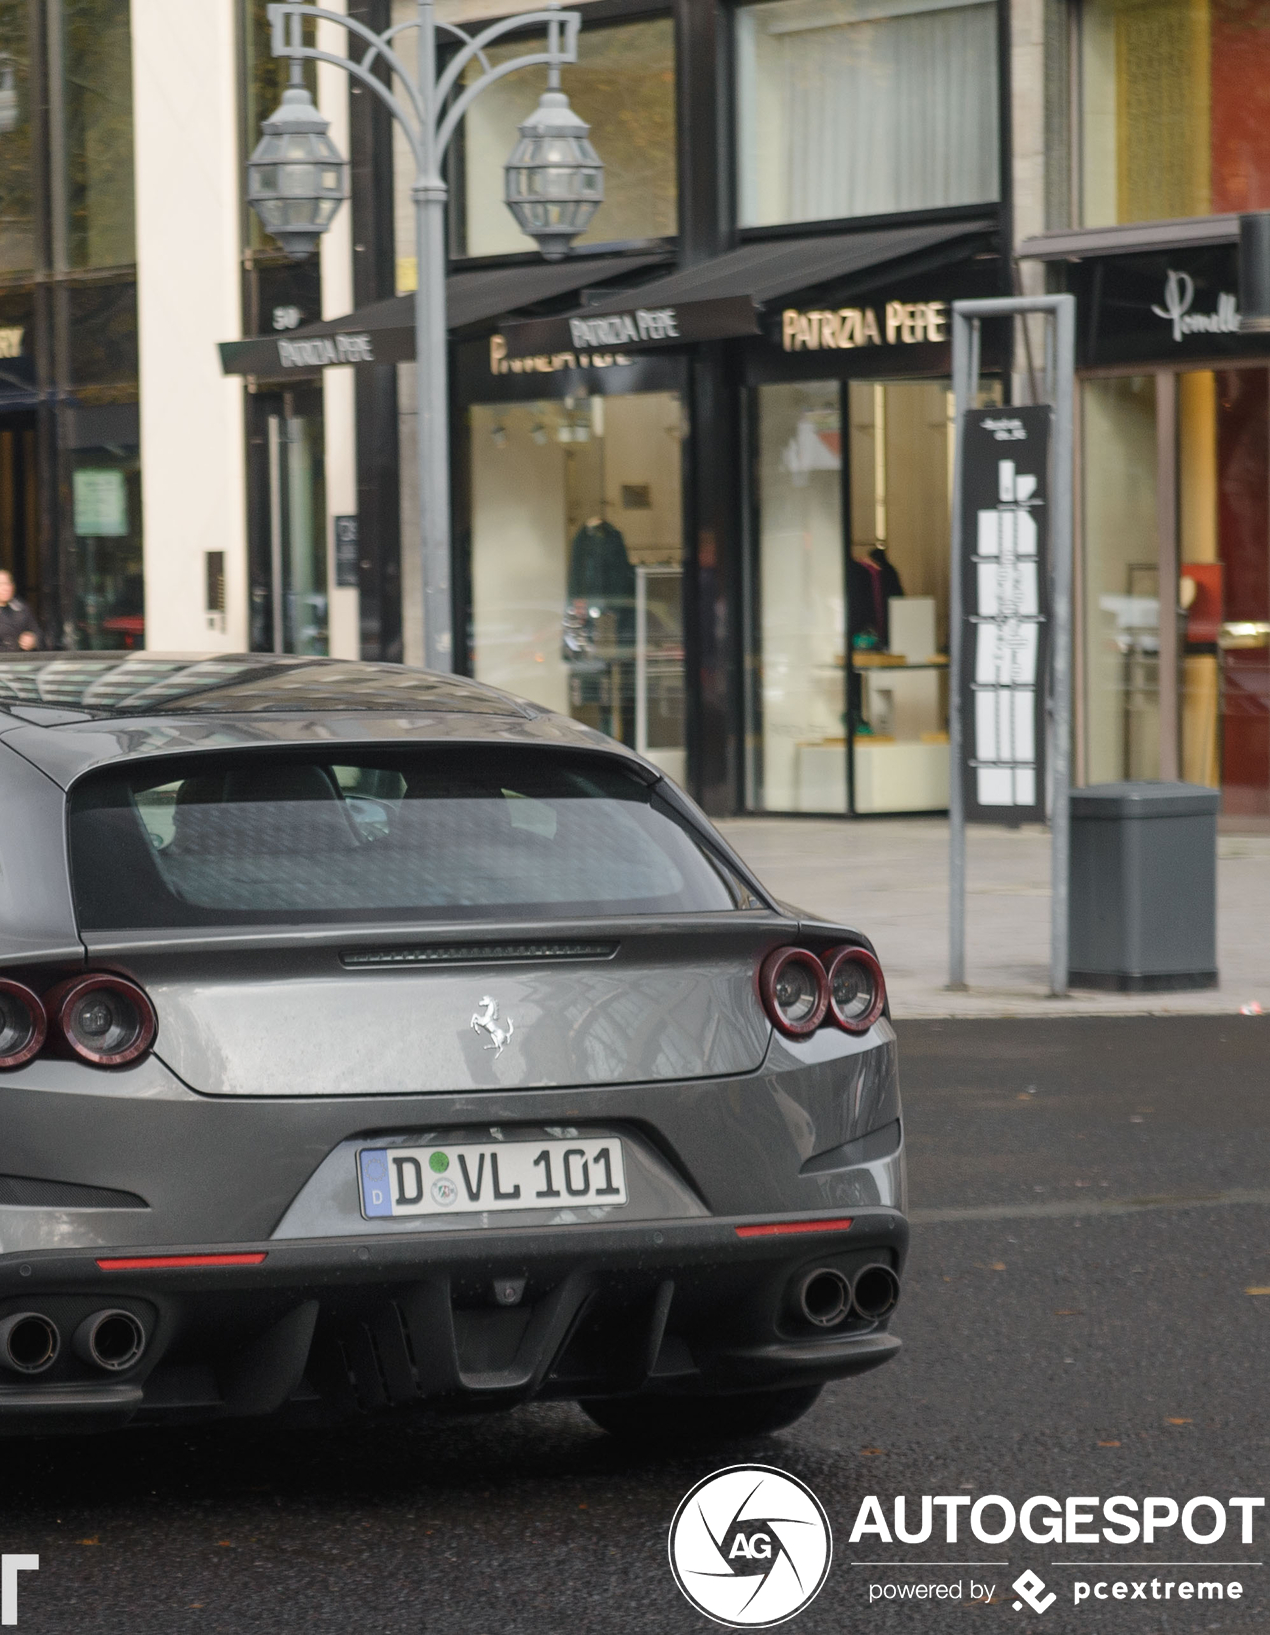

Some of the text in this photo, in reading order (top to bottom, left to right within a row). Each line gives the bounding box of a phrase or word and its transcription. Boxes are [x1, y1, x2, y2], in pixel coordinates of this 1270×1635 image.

[334, 333, 375, 363] PEPE
[569, 308, 680, 349] PATRIZIA PEPE
[783, 300, 947, 352] PATRIZIA PEPE
[392, 1156, 424, 1206] D
[457, 1152, 521, 1202] VL
[533, 1147, 621, 1198] 101
